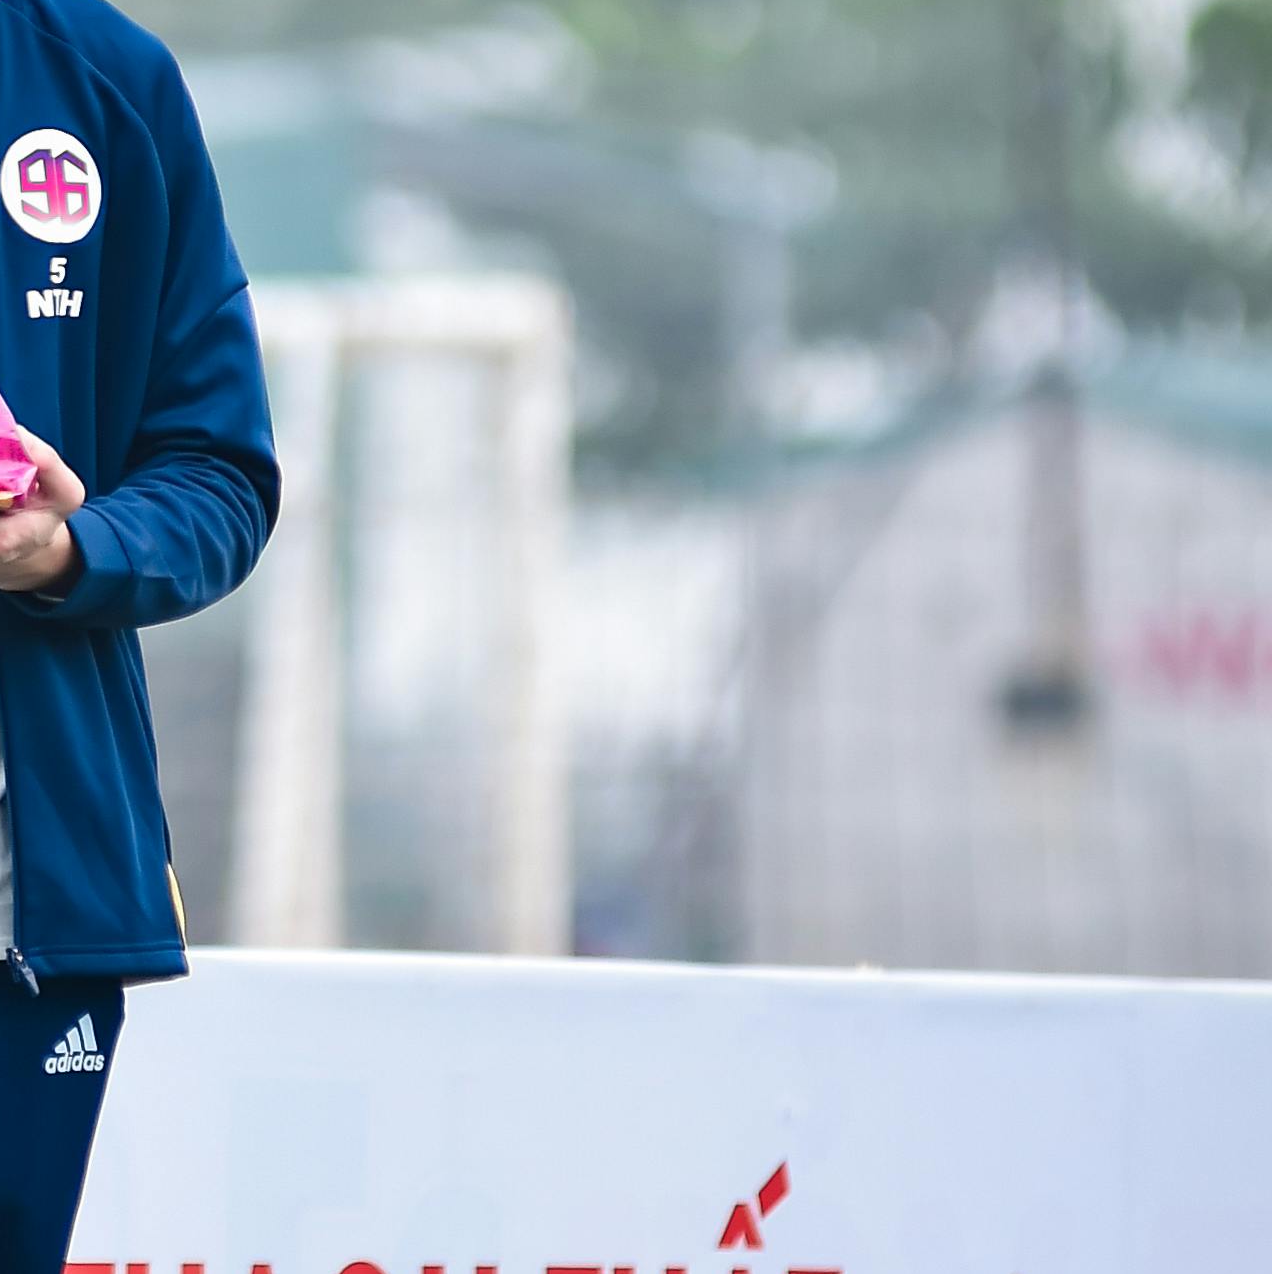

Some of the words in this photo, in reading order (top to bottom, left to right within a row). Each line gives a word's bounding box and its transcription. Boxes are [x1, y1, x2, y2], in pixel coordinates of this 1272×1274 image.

[49, 257, 68, 284] 5
[26, 289, 84, 318] NTH
[44, 1051, 105, 1074] adidas
